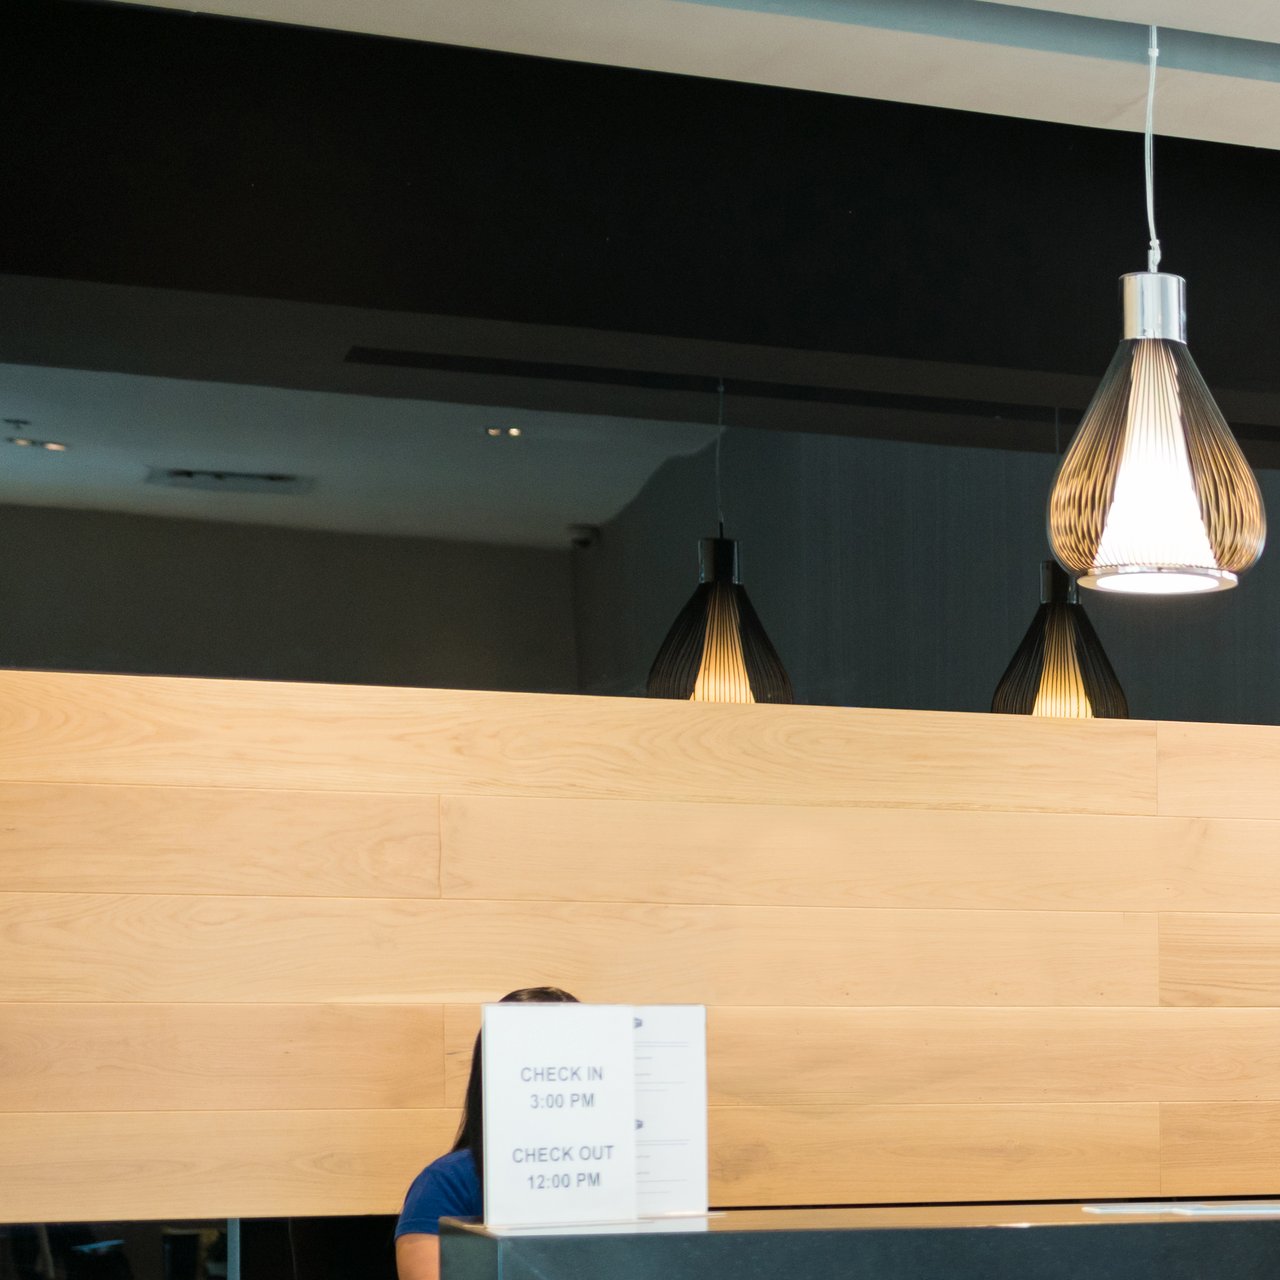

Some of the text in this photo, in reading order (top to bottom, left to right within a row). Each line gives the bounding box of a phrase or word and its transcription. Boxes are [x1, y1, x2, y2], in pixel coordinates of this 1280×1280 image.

[520, 1066, 603, 1082] CHECK IN
[530, 1093, 595, 1109] 3:00 PM
[512, 1145, 615, 1163] CHECK OUT
[527, 1173, 601, 1190] 12:00 PM
